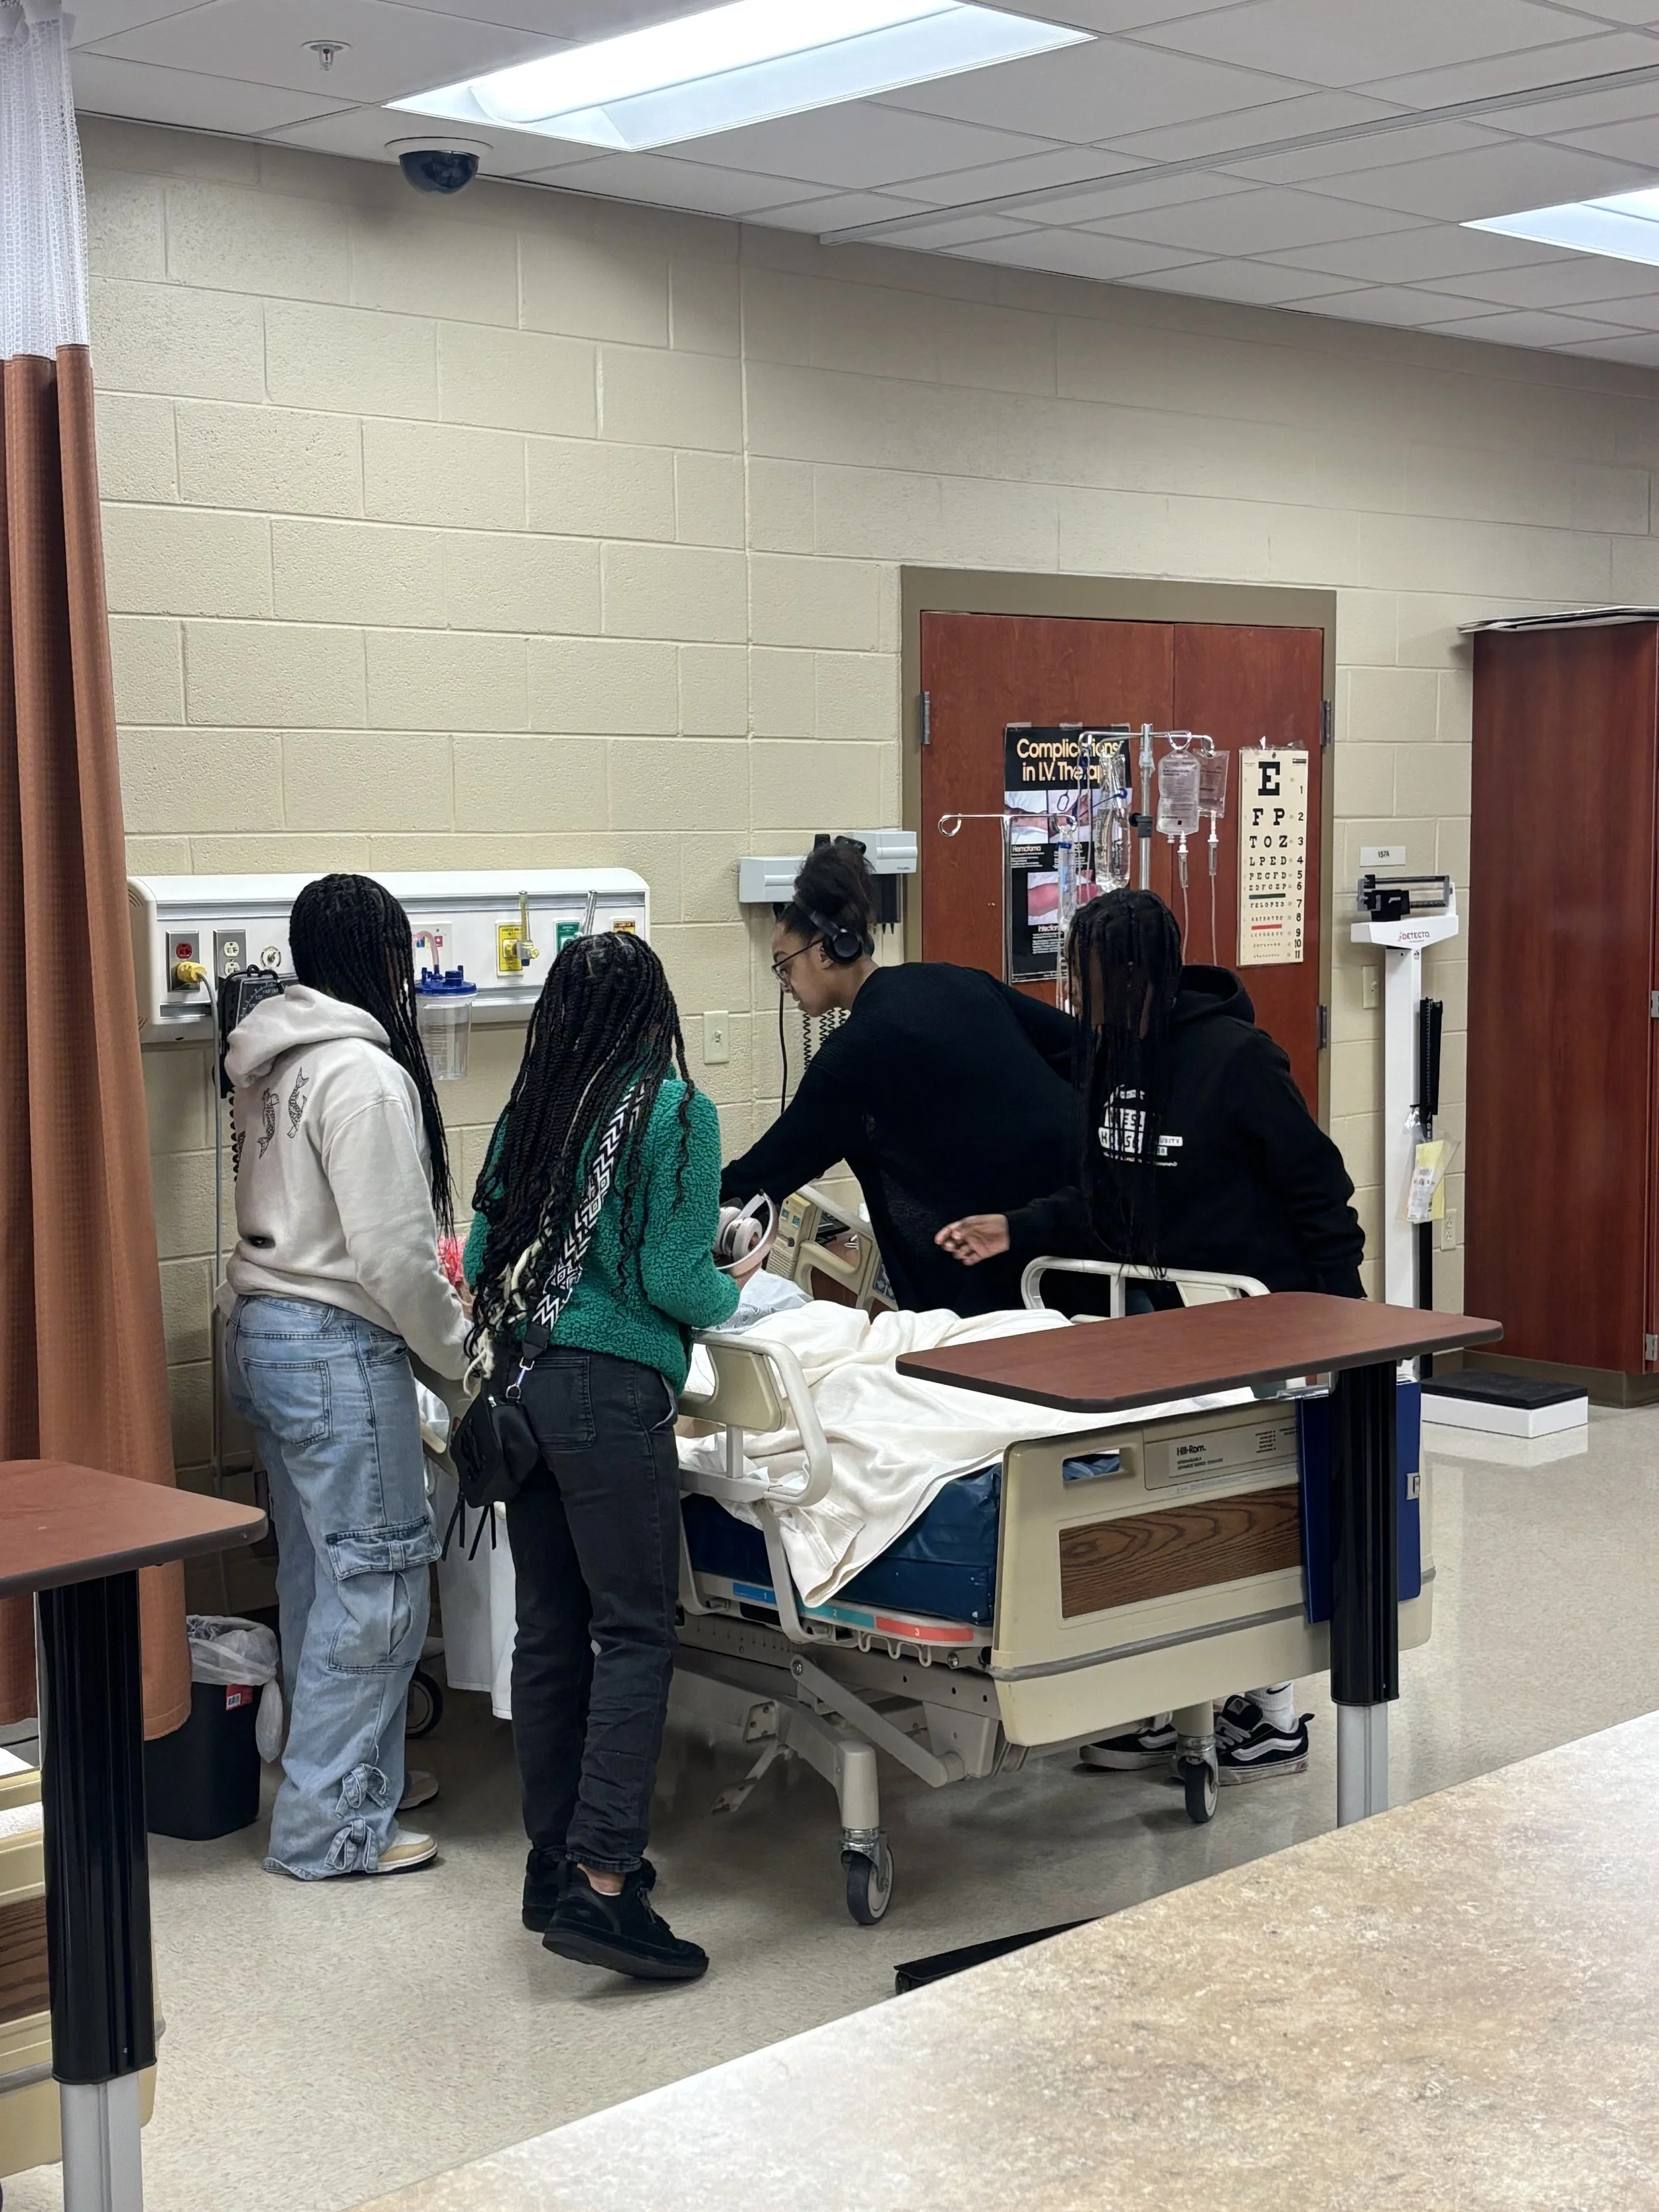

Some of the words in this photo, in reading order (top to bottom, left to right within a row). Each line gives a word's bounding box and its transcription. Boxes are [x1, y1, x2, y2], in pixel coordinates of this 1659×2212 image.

[1023, 762, 1035, 781] in
[1039, 761, 1056, 781] I.V.
[1258, 761, 1281, 796] E
[1299, 785, 1303, 794] 1
[1297, 812, 1304, 822] 2
[1297, 836, 1304, 846] 3
[1297, 855, 1304, 865] 4
[1297, 870, 1303, 879] 5
[1296, 881, 1302, 891] 6
[1296, 899, 1303, 909] 7
[1296, 913, 1301, 922] 8
[1295, 928, 1301, 937] 9
[1294, 938, 1302, 948] 10
[1295, 950, 1301, 959] 11
[914, 1627, 920, 1637] 3
